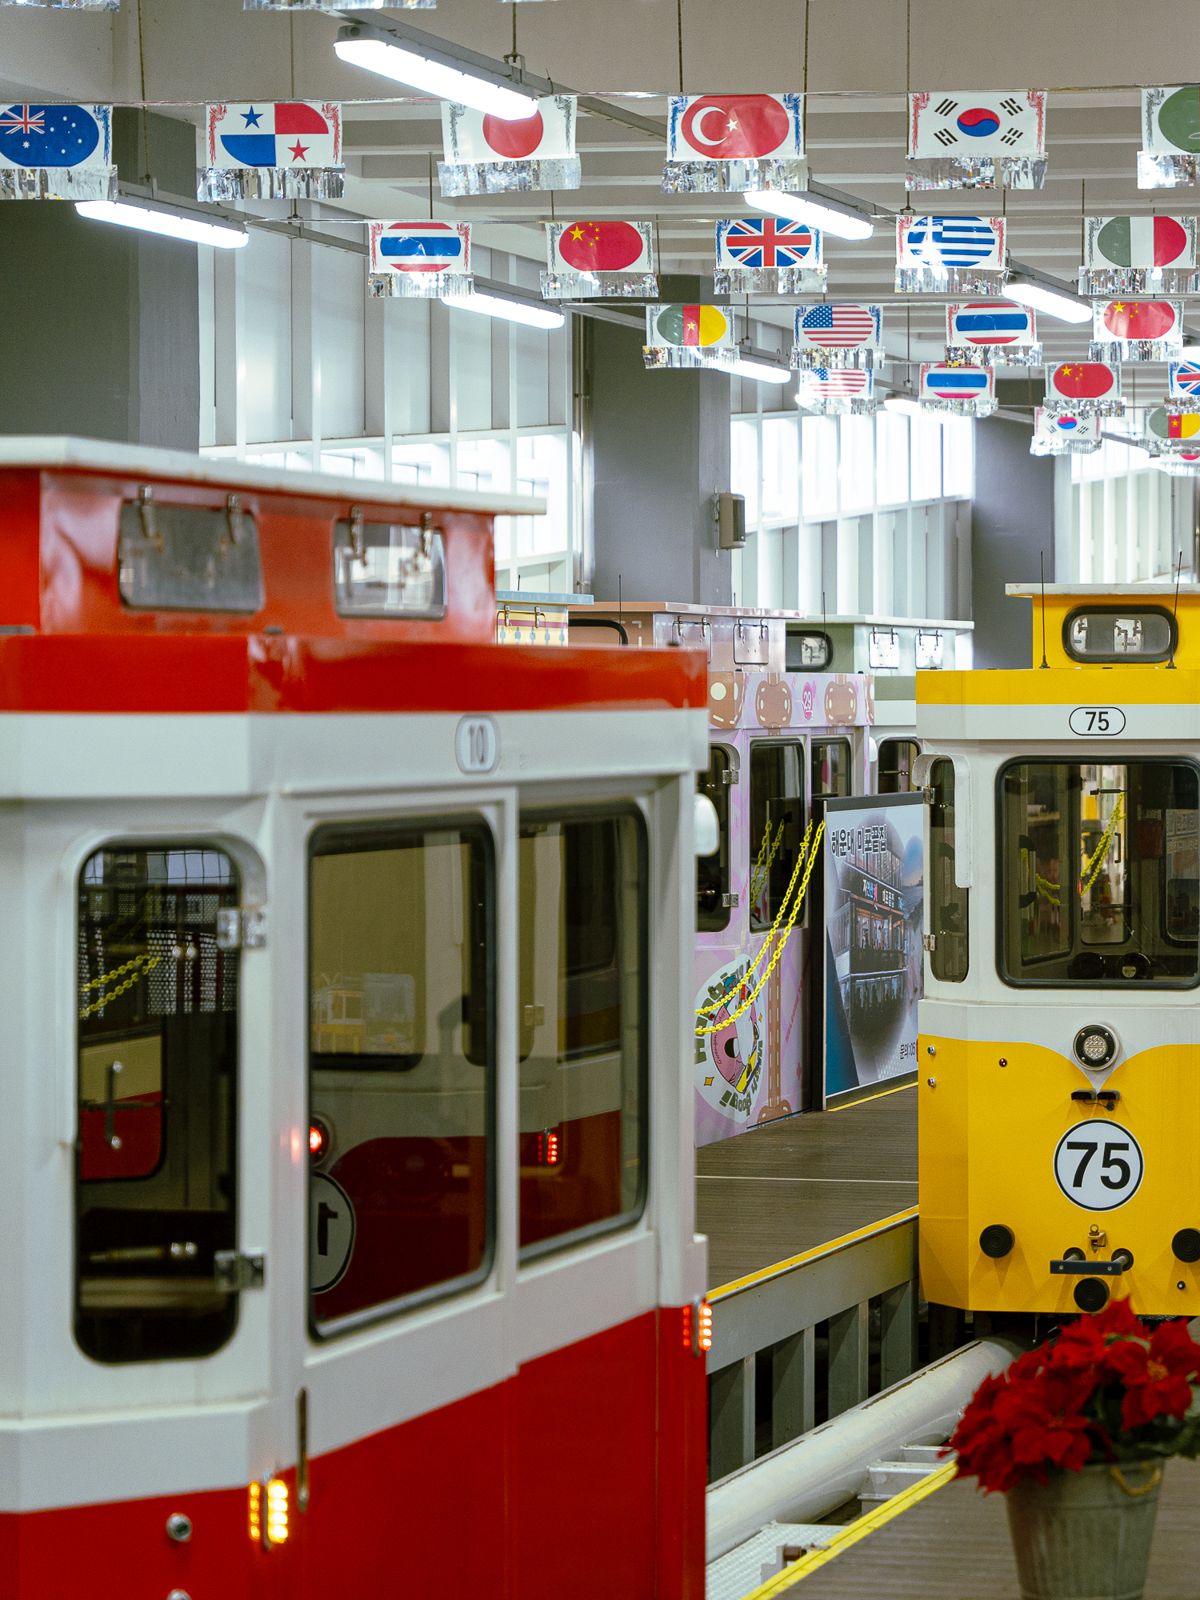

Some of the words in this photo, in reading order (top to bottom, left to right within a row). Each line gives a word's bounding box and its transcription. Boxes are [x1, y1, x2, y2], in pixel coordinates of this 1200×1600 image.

[1085, 711, 1110, 731] 75
[832, 828, 855, 858] 해운대
[1066, 1141, 1131, 1190] 75
